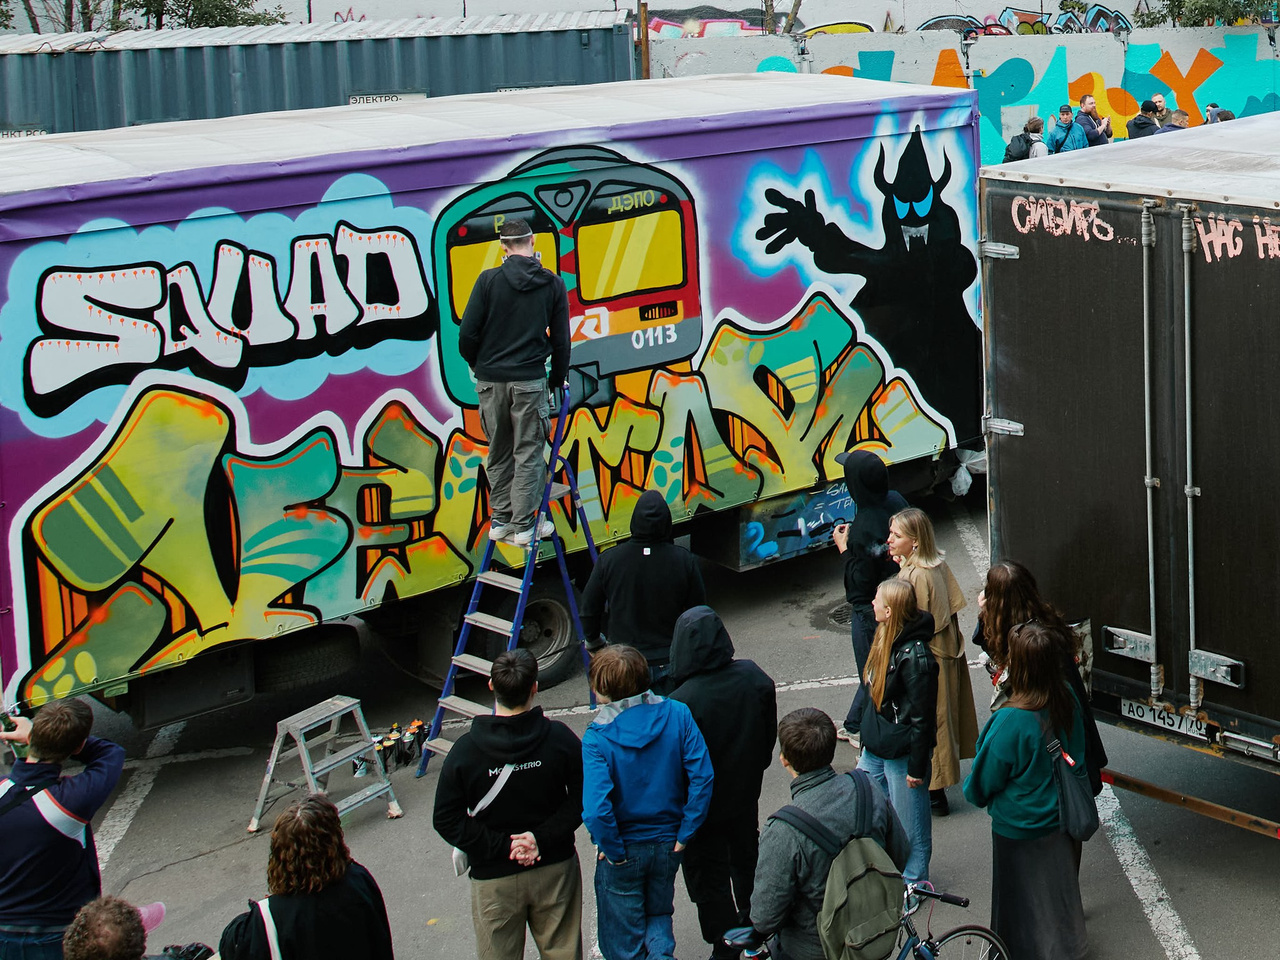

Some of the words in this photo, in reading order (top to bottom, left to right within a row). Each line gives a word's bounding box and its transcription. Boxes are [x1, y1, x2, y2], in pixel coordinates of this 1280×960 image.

[608, 189, 655, 215] ДЭПО
[1193, 211, 1244, 264] НАС
[26, 222, 433, 400] SQUAD
[631, 324, 678, 349] 0113
